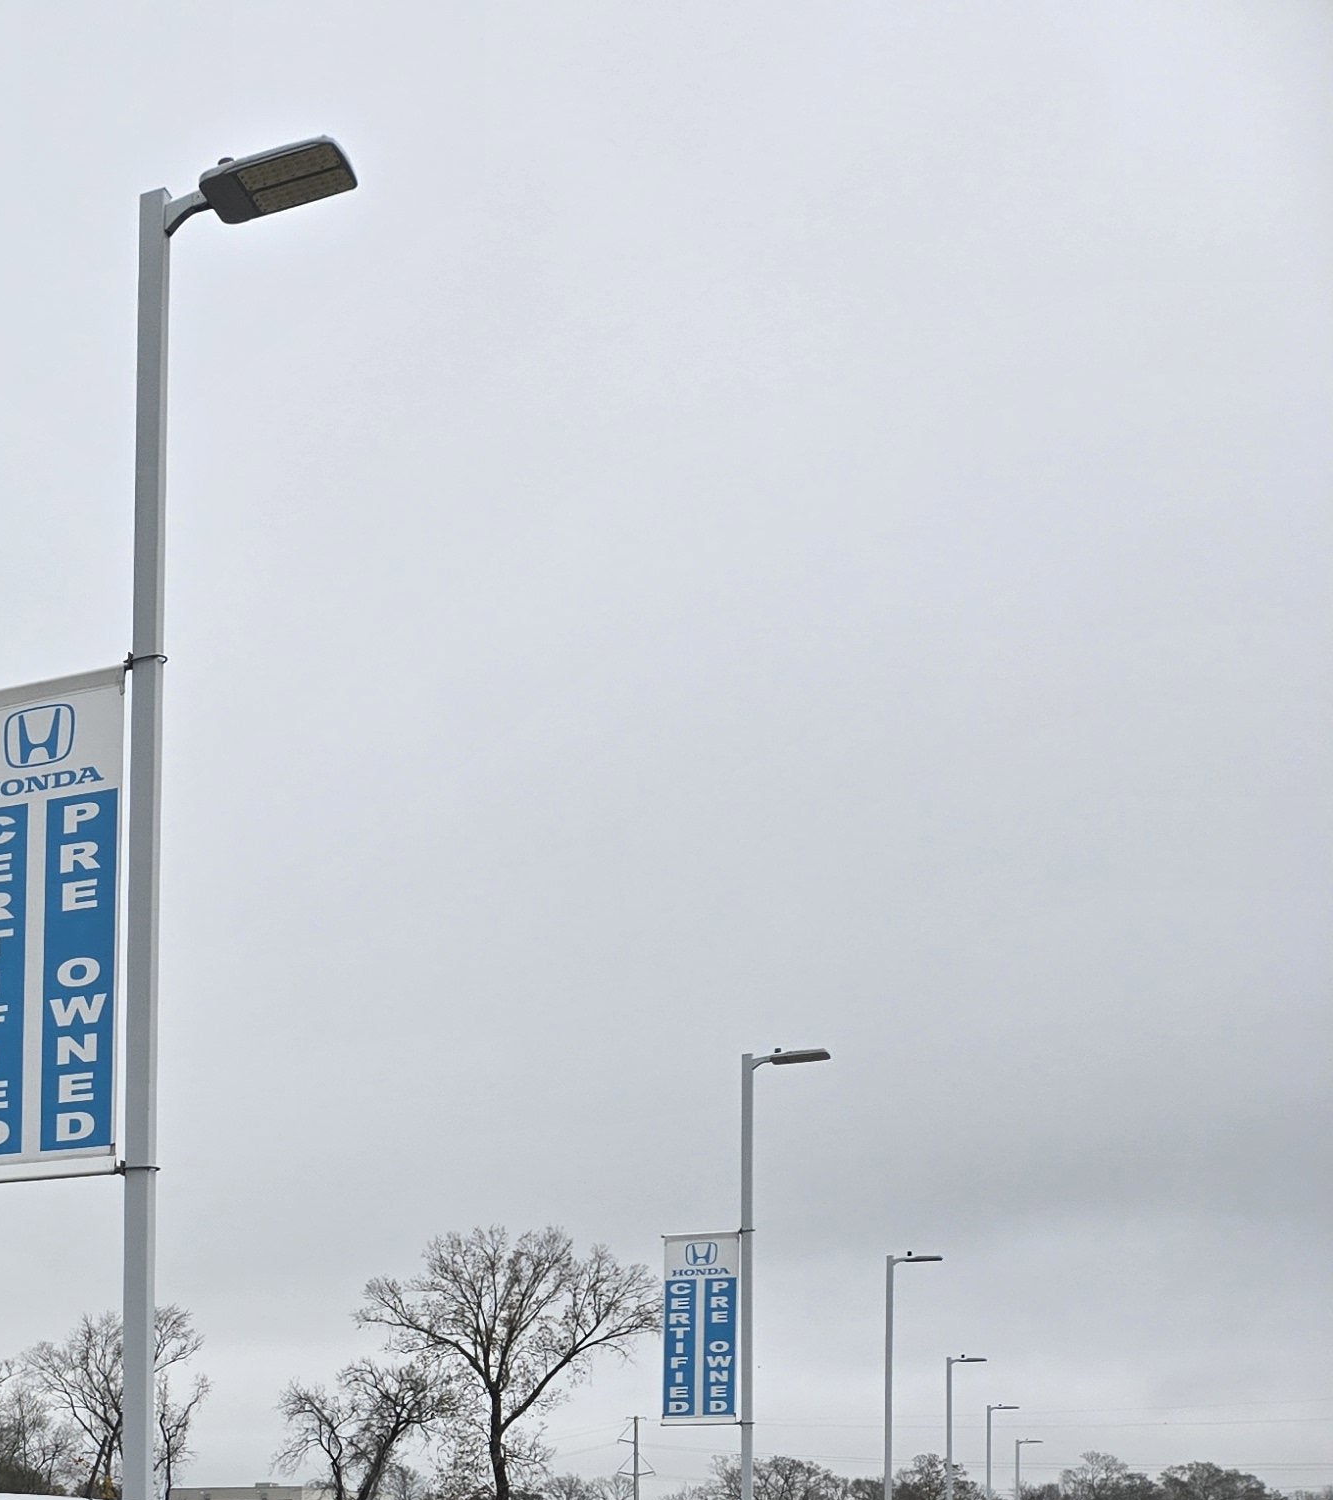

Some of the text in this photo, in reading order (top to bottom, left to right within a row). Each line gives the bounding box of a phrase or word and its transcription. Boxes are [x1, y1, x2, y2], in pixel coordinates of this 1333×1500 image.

[49, 801, 108, 1142] PRE OWNED
[671, 1267, 731, 1277] HONDA
[668, 1282, 692, 1414] CERTIFIED
[706, 1281, 733, 1413] PRE OWNED
